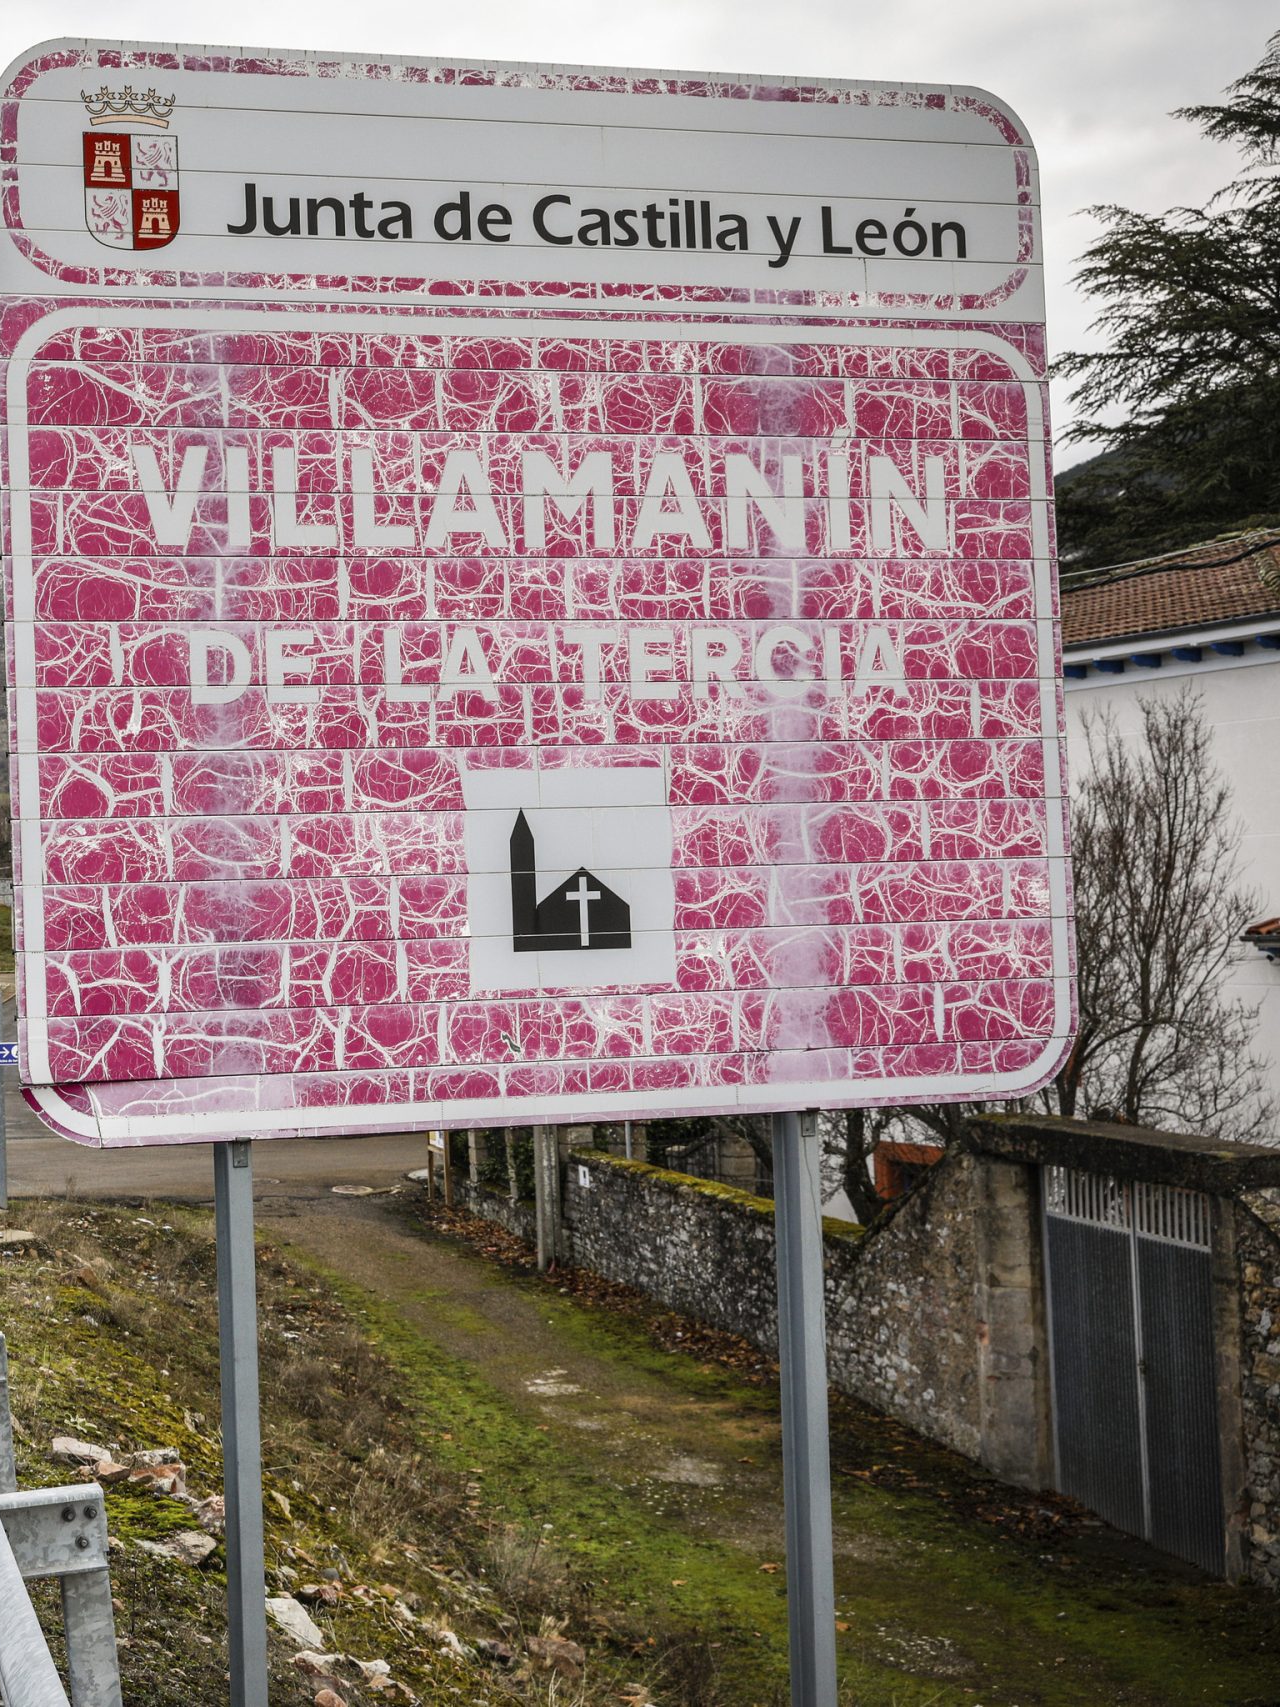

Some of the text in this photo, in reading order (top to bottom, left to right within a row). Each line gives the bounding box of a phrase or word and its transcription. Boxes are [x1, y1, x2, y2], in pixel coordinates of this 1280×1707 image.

[226, 182, 967, 268] Junta de Castilla y León
[131, 428, 949, 551] VILLAMANÍN
[189, 625, 910, 704] DE LA TERCIA
